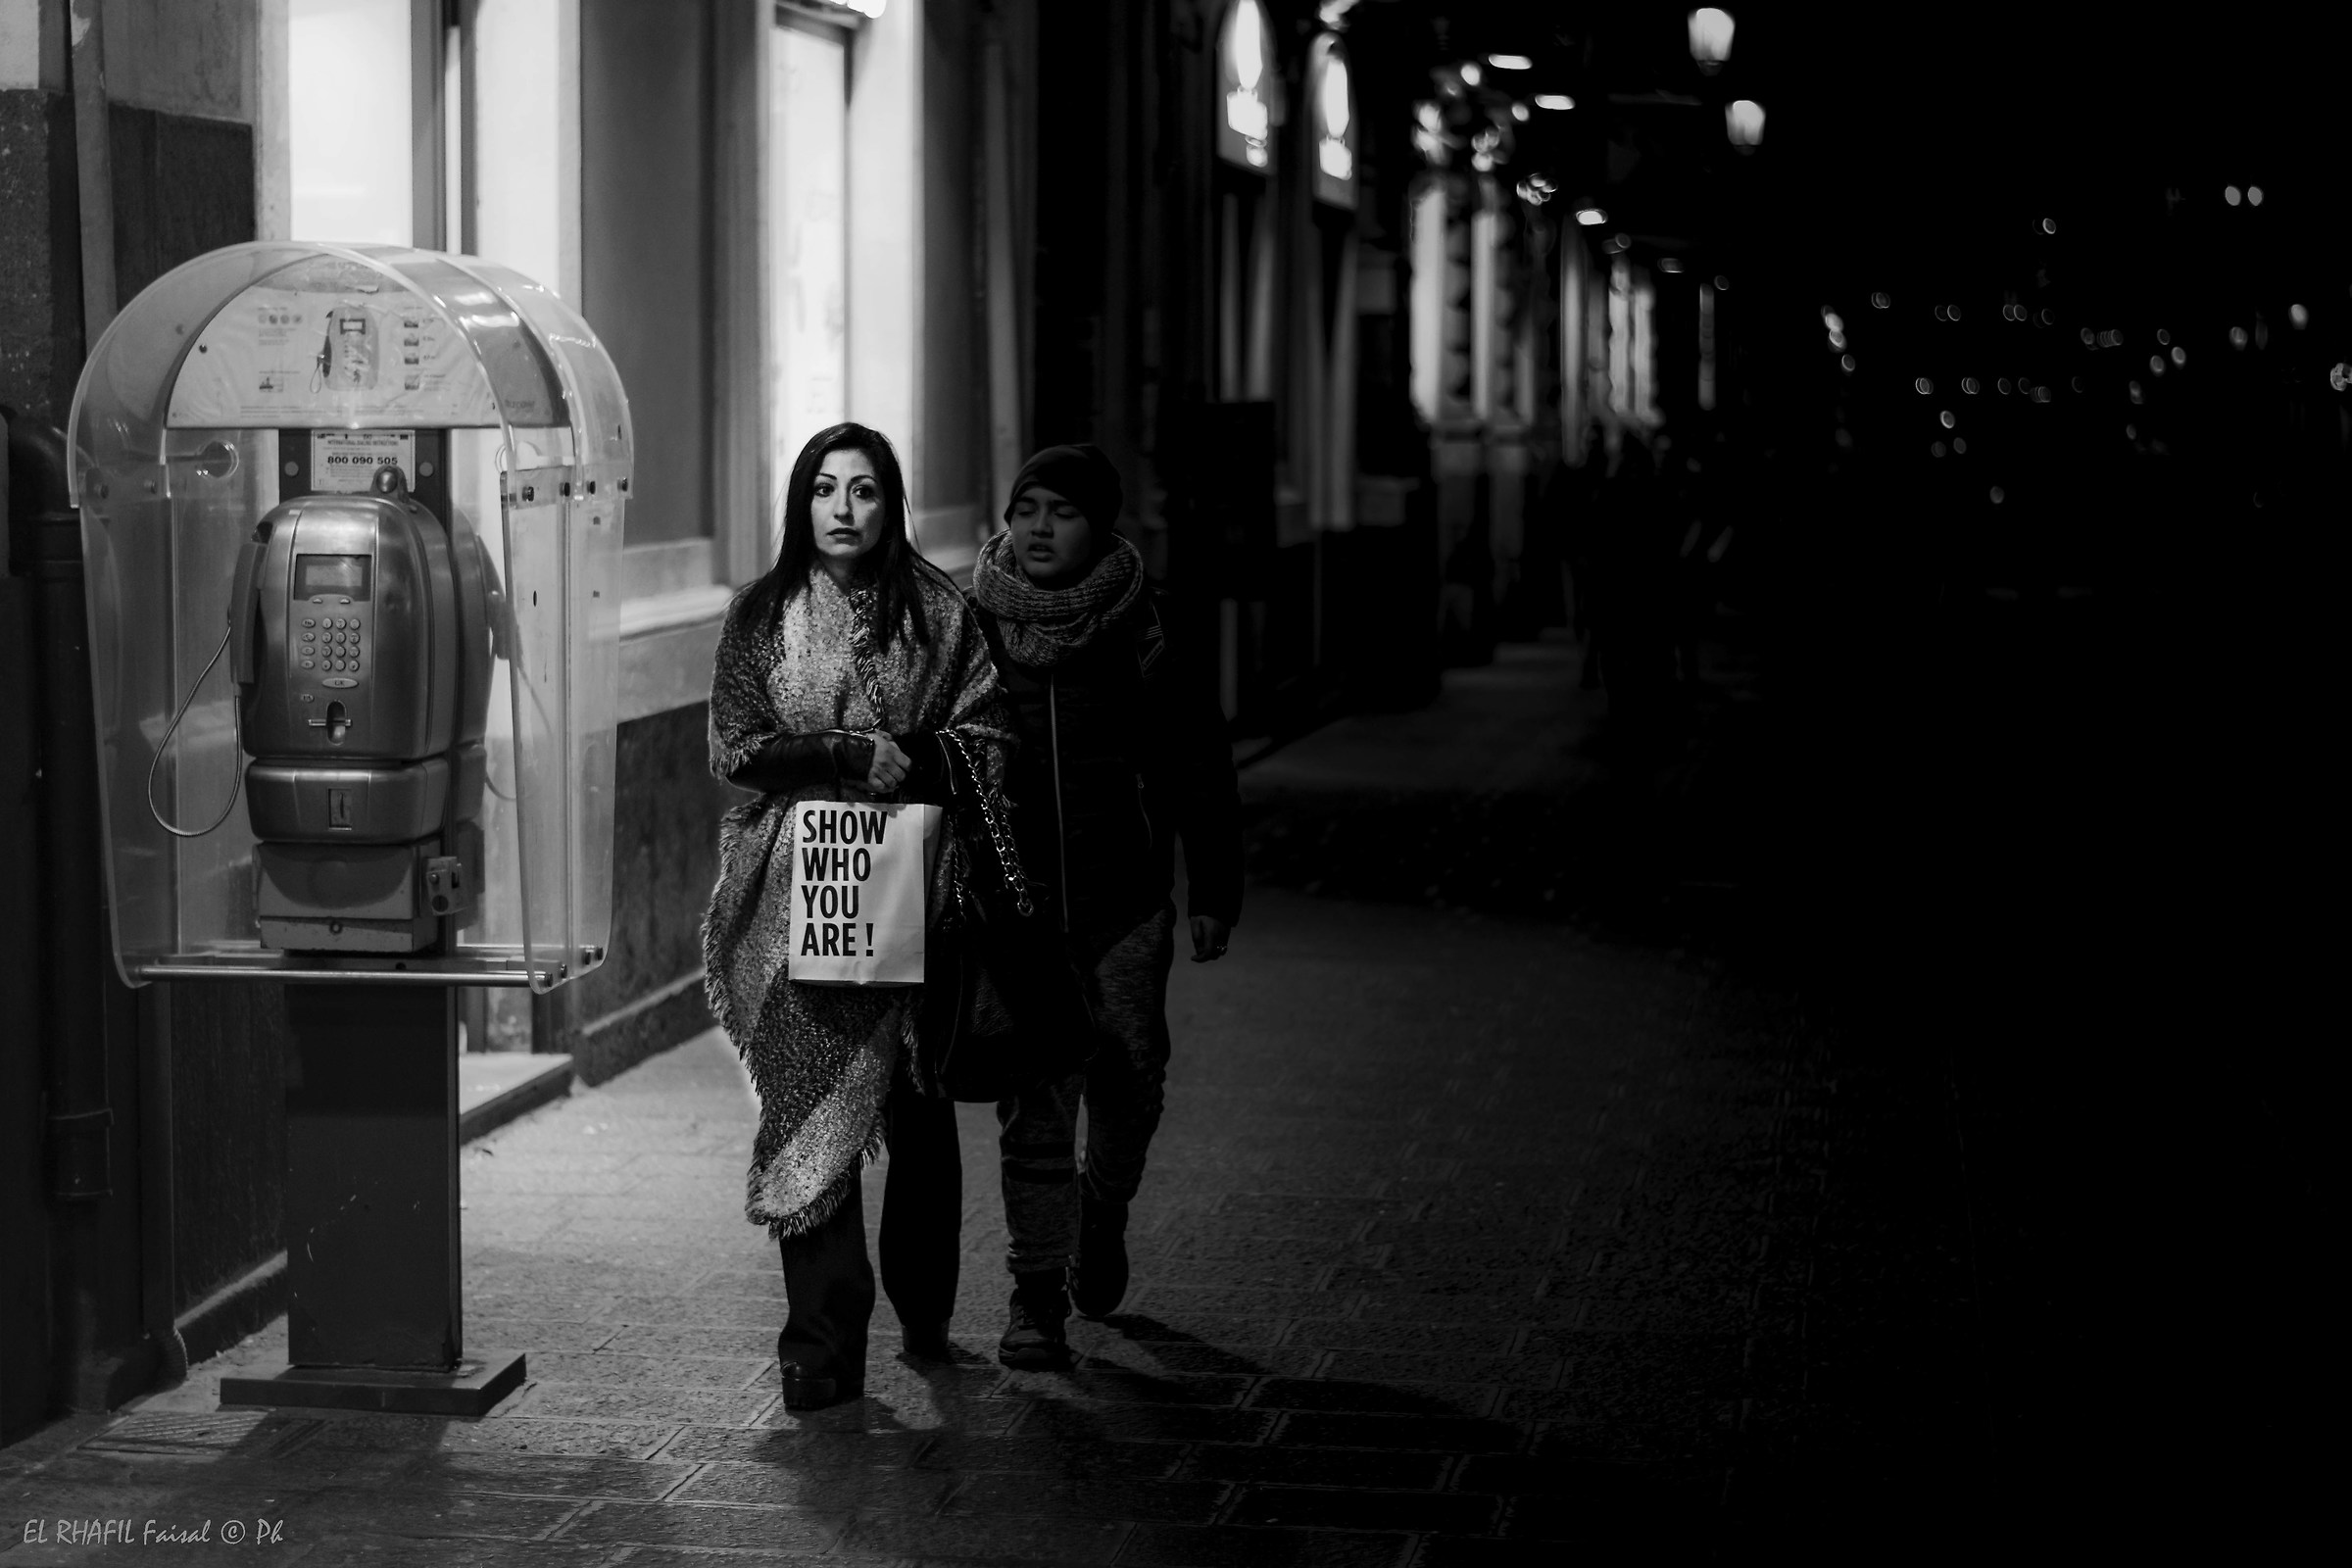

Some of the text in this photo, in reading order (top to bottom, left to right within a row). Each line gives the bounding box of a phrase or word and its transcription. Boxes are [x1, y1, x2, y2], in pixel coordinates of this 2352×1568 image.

[327, 456, 349, 465] 800
[352, 456, 373, 465] 090
[802, 809, 888, 845] SHOW
[802, 847, 871, 882] WHO
[801, 885, 859, 919] YOU
[801, 922, 857, 956] ARE
